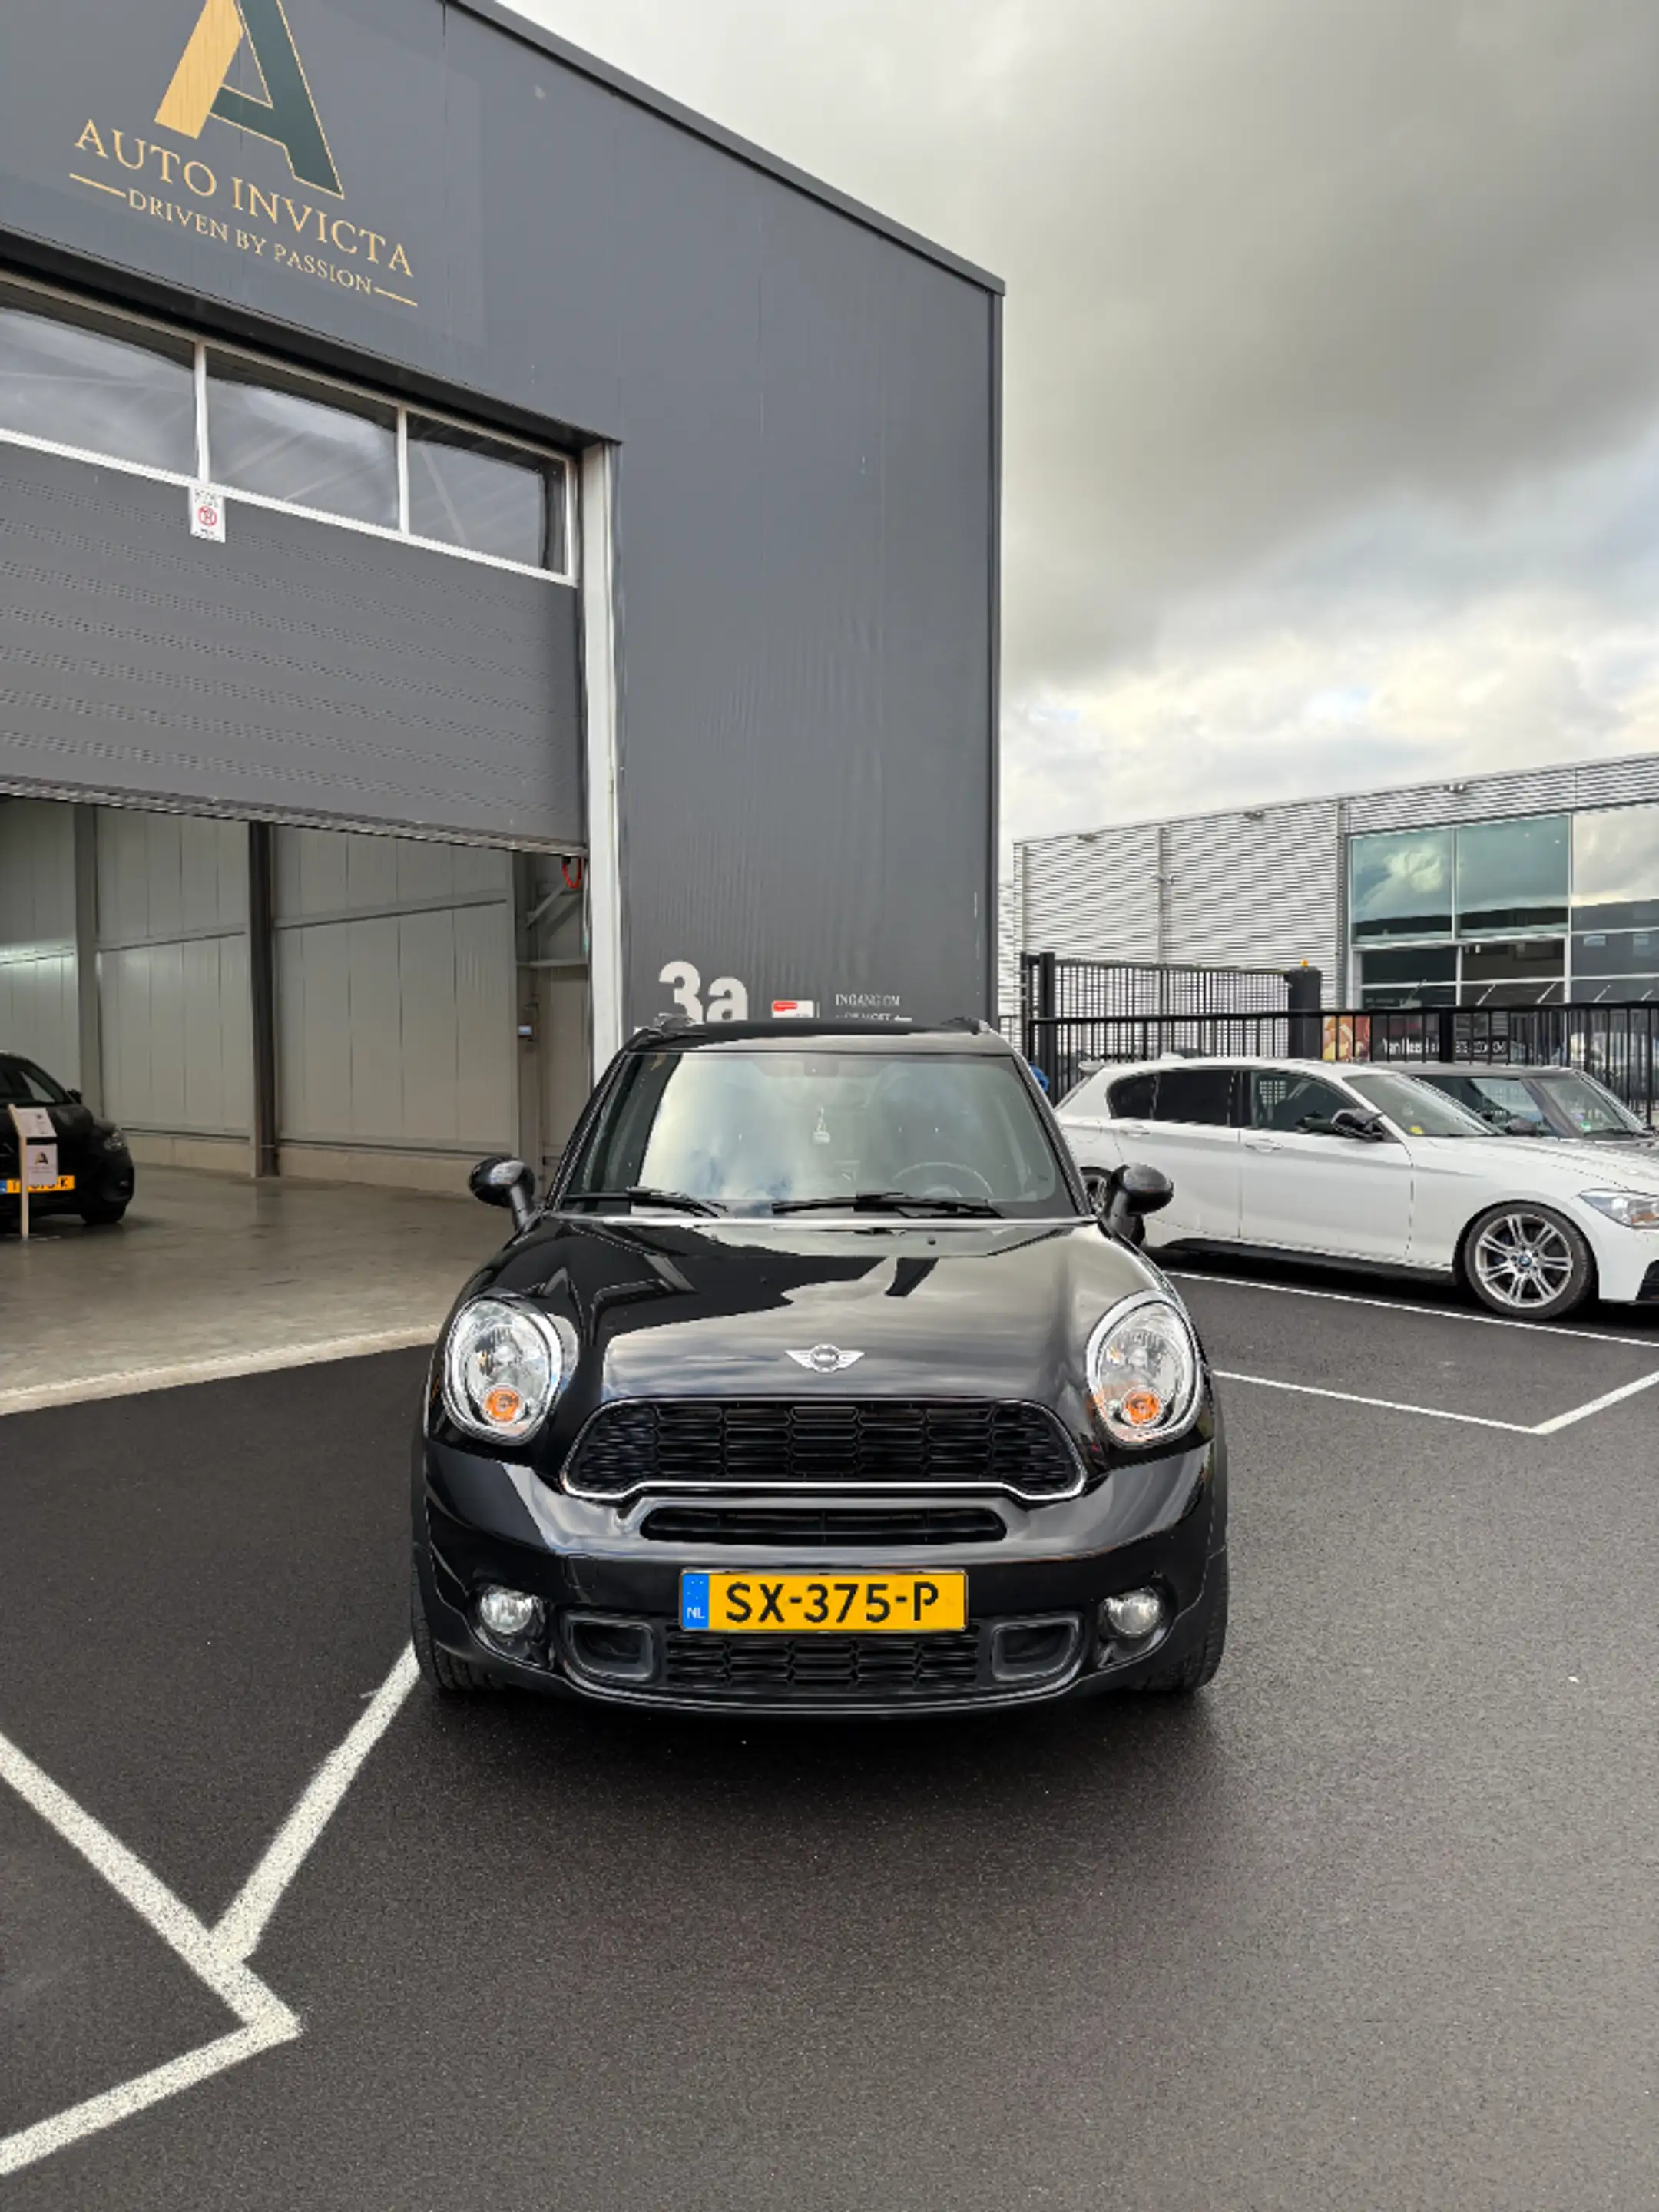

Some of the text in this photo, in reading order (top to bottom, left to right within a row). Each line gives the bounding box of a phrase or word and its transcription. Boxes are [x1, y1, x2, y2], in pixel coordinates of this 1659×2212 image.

[75, 118, 415, 278] AUTO INVICTA
[129, 188, 373, 295] DRIVEN BY PASSION
[658, 960, 748, 1025] 3a
[686, 1606, 706, 1620] NL
[726, 1581, 939, 1624] SX-375-P
